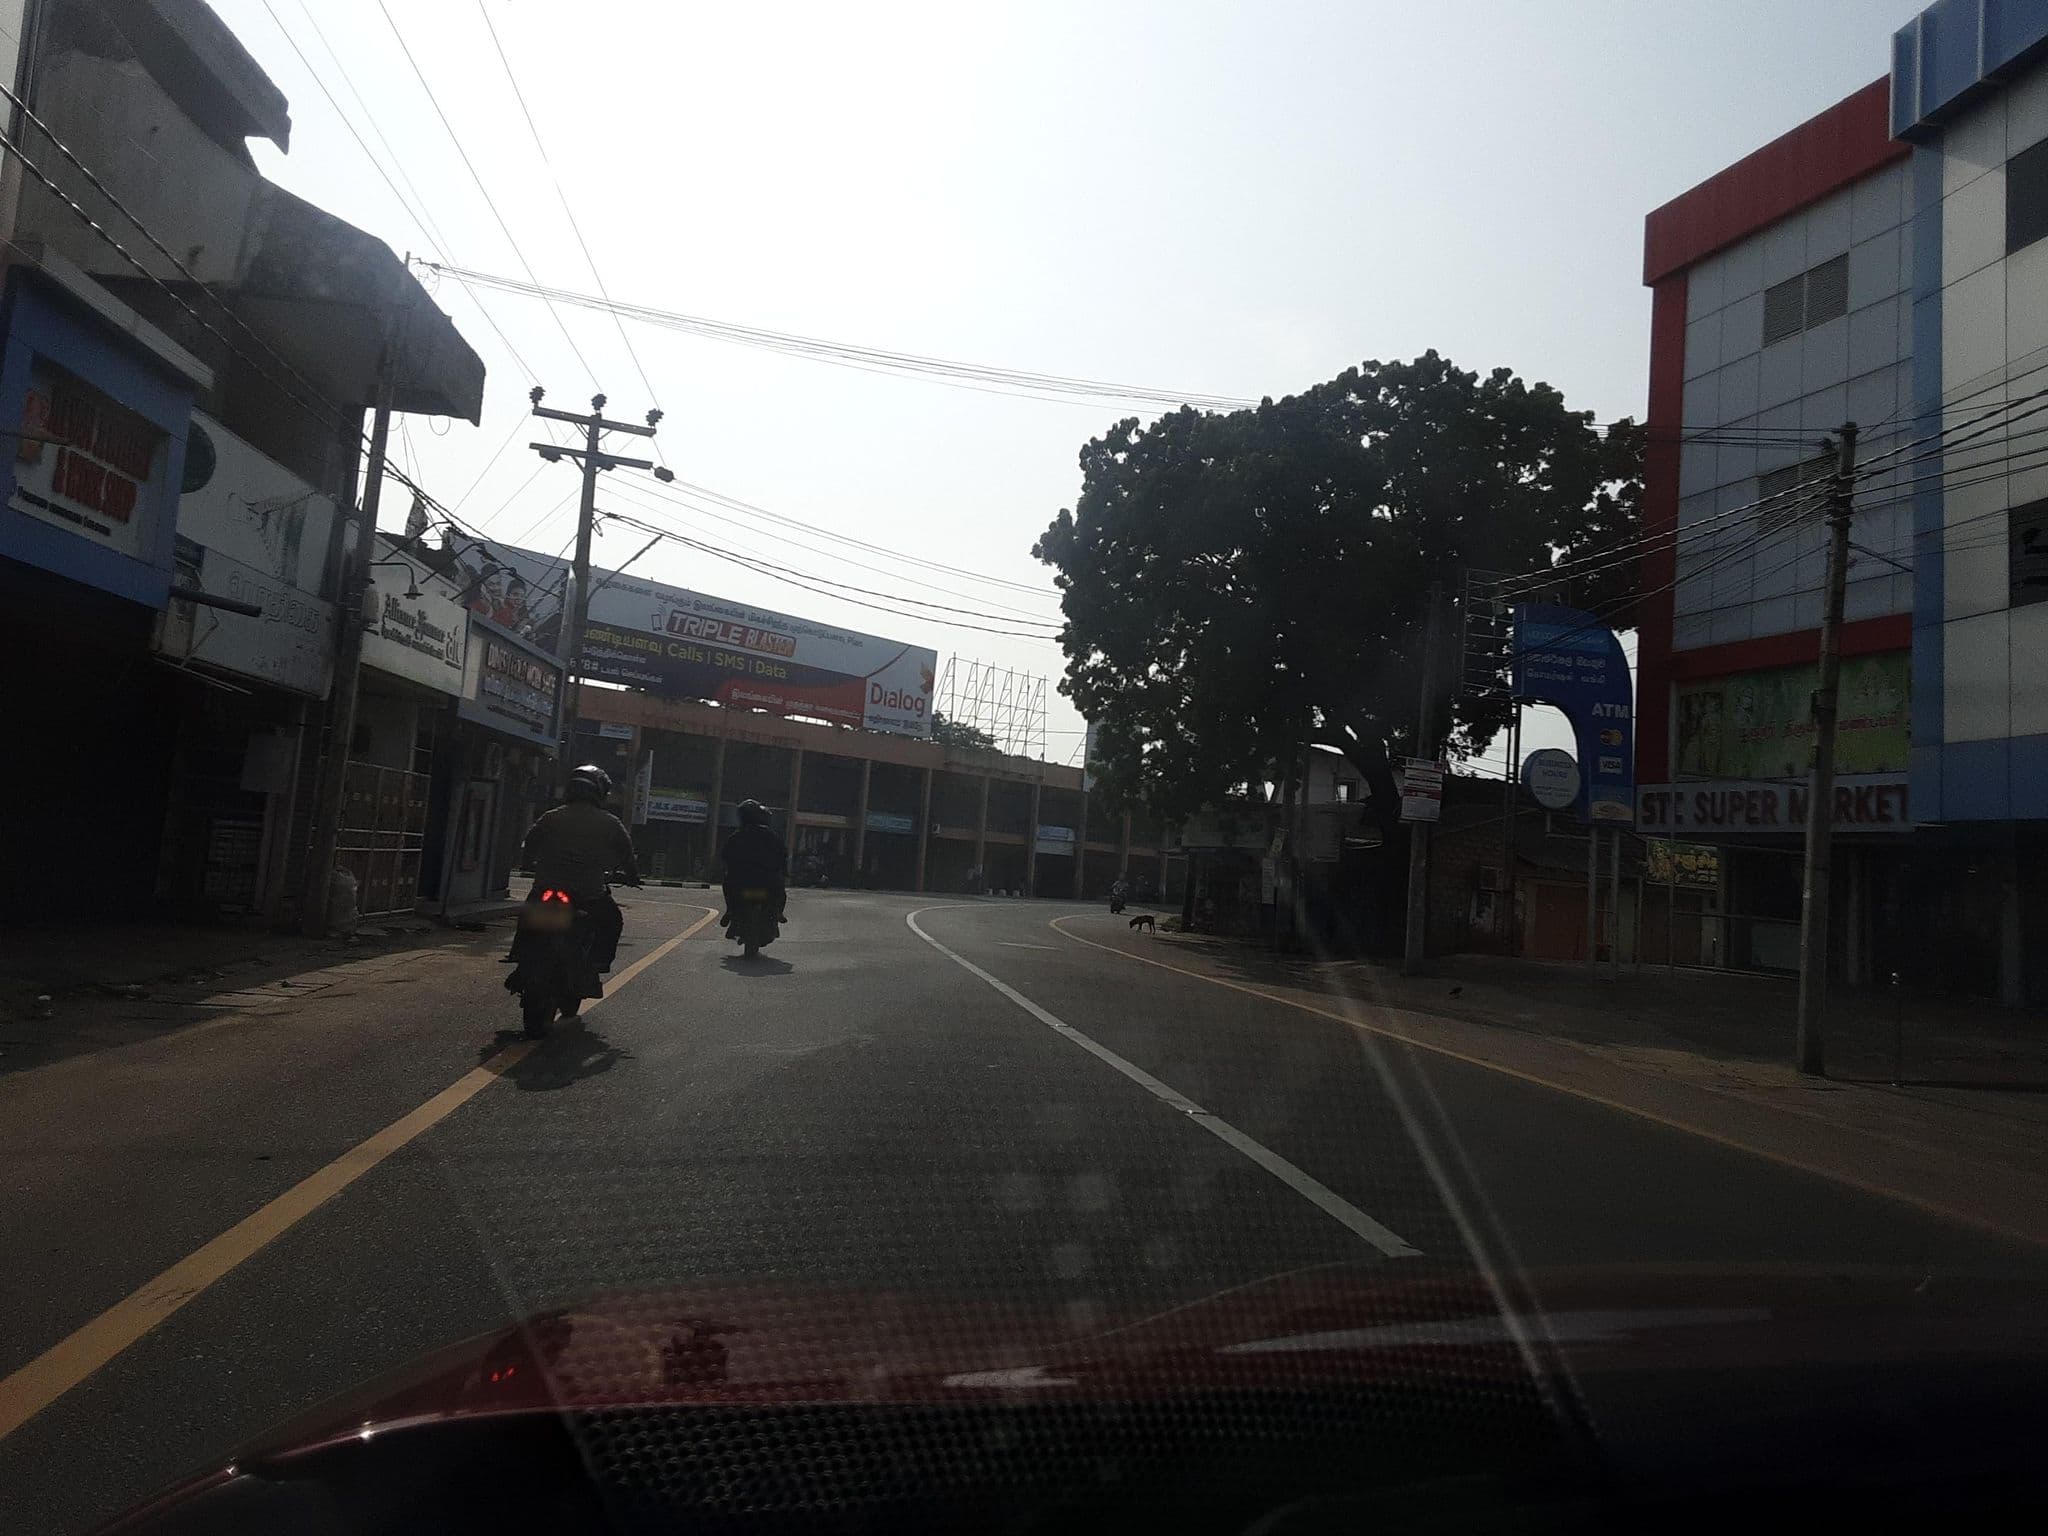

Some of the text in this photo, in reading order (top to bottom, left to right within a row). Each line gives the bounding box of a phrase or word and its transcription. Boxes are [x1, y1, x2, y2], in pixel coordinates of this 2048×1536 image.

[672, 613, 795, 656] TRIPLE BLASTER
[668, 643, 703, 663] Calls
[715, 653, 745, 669] SMS
[755, 660, 786, 678] Data
[870, 682, 926, 718] Dialog
[1592, 702, 1630, 719] ATM
[1542, 770, 1568, 779] HOURS
[1602, 760, 1621, 770] VISA
[1694, 789, 1779, 825] SUPER
